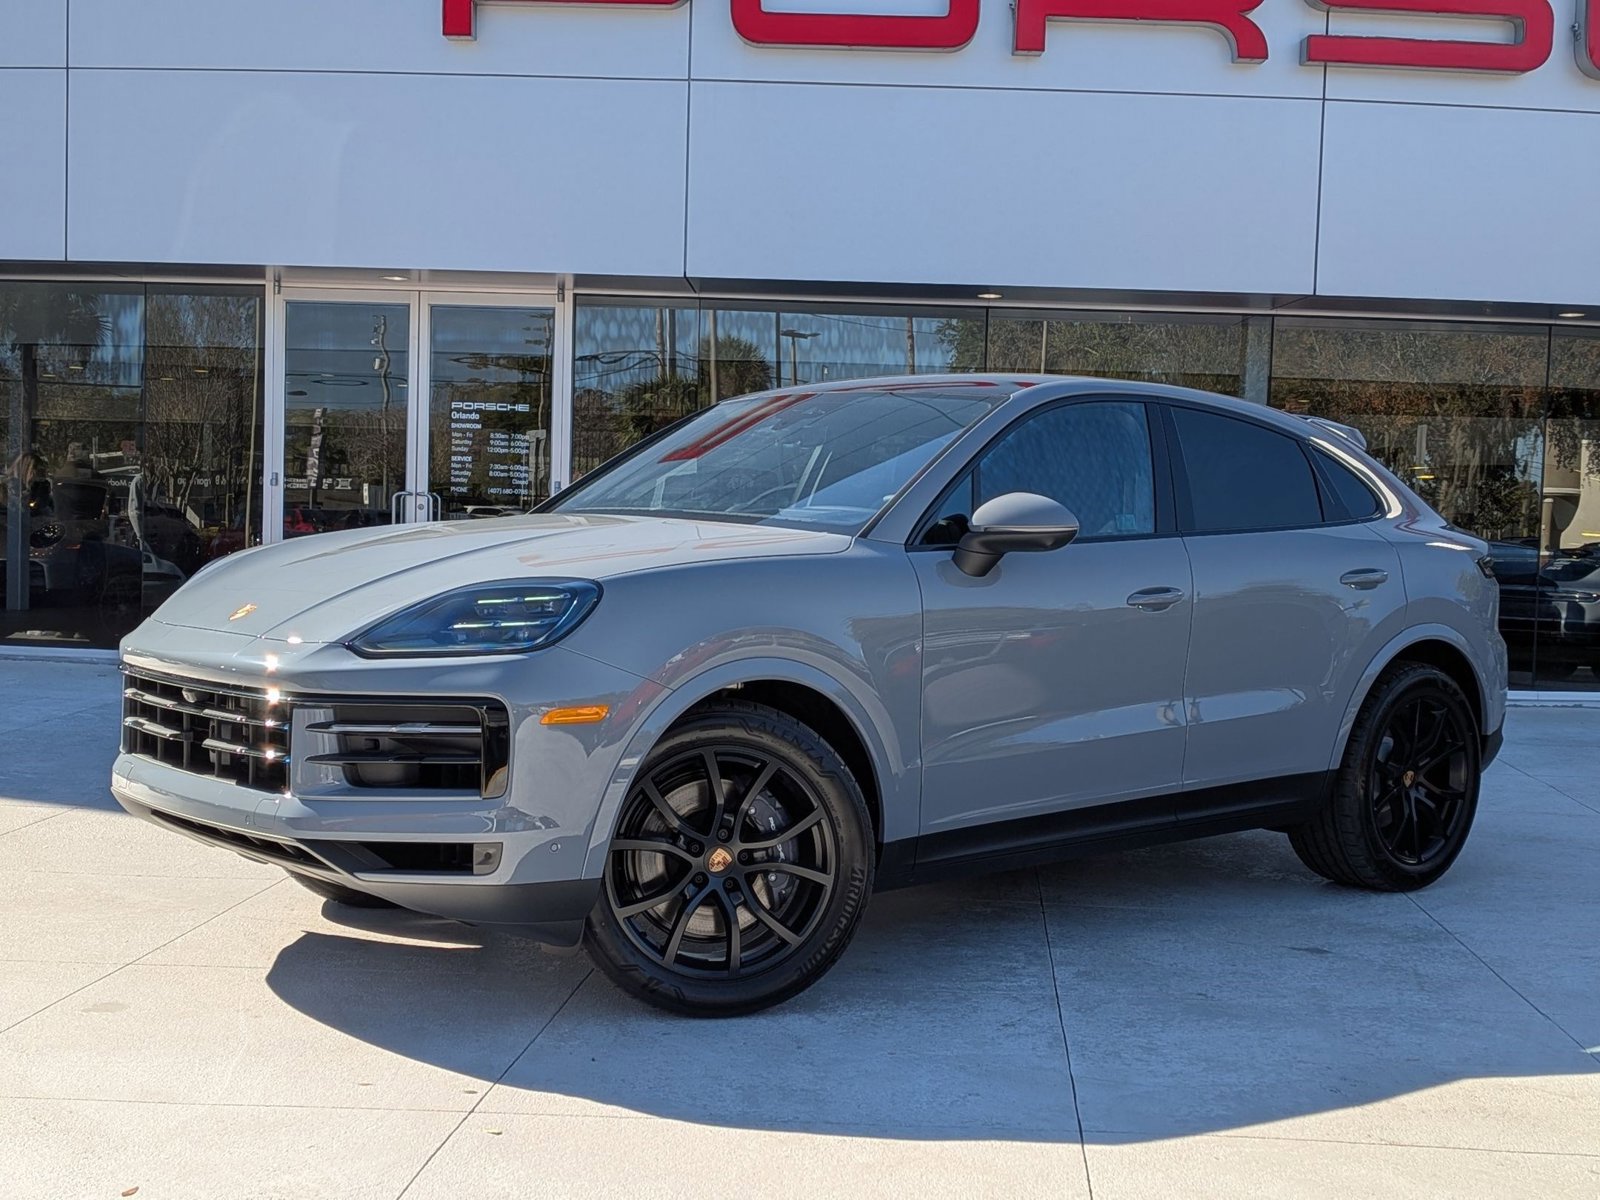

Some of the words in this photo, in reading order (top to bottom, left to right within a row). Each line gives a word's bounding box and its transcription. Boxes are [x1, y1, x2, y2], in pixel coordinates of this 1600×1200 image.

[451, 401, 530, 412] PORSCHE
[451, 411, 480, 420] Orlando
[451, 438, 473, 446] Saturday
[451, 445, 470, 453] Sunday
[450, 469, 472, 477] Saturday
[450, 476, 469, 484] Sunday
[487, 487, 502, 495] (407)
